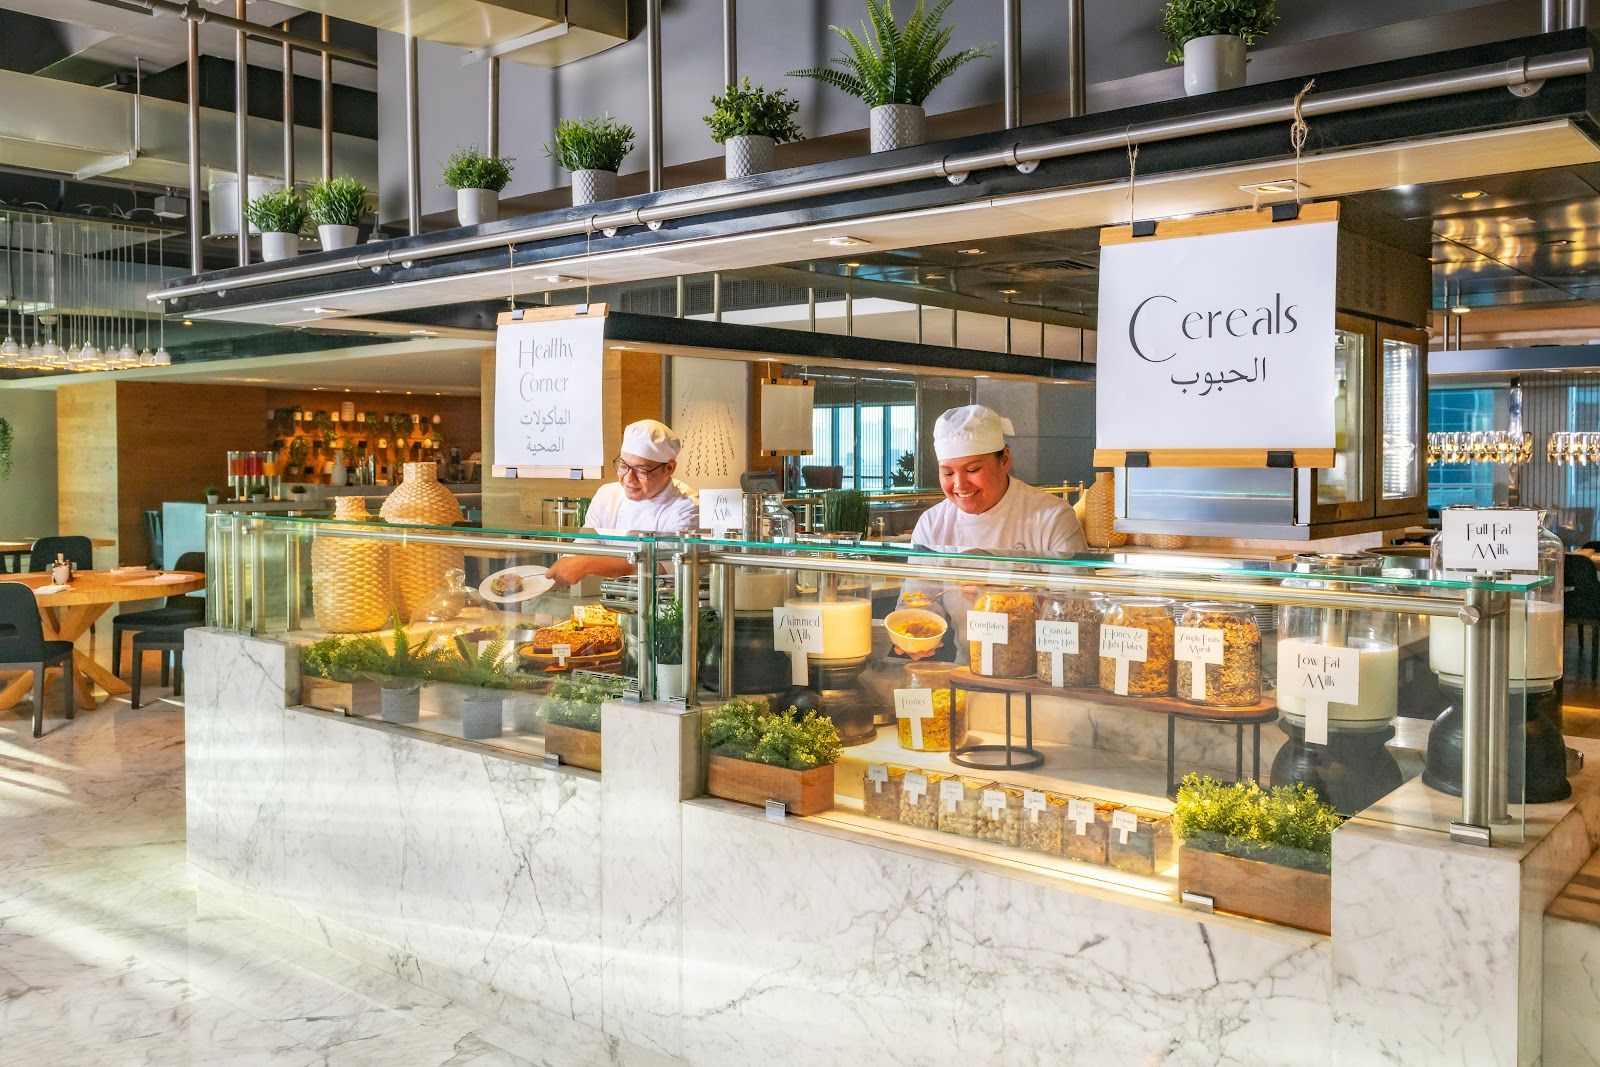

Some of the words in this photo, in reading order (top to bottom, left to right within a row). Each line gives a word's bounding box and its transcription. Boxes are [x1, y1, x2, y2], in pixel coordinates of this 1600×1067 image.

[1129, 293, 1298, 362] Cereals
[519, 337, 577, 369] Healthy
[1171, 357, 1266, 396] الحبوب
[519, 372, 569, 402] Corner
[520, 405, 571, 432] المأكولات
[526, 436, 564, 456] الصحية
[1467, 523, 1488, 541] Full
[1492, 523, 1512, 541] Fat
[1471, 543, 1509, 560] Milk
[775, 614, 820, 630] Skimmed
[785, 628, 811, 644] Milk
[1104, 628, 1131, 640] Honey
[1133, 631, 1144, 641] &
[1297, 653, 1320, 669] Low
[1323, 655, 1341, 673] Fat
[1302, 673, 1335, 690] Milk
